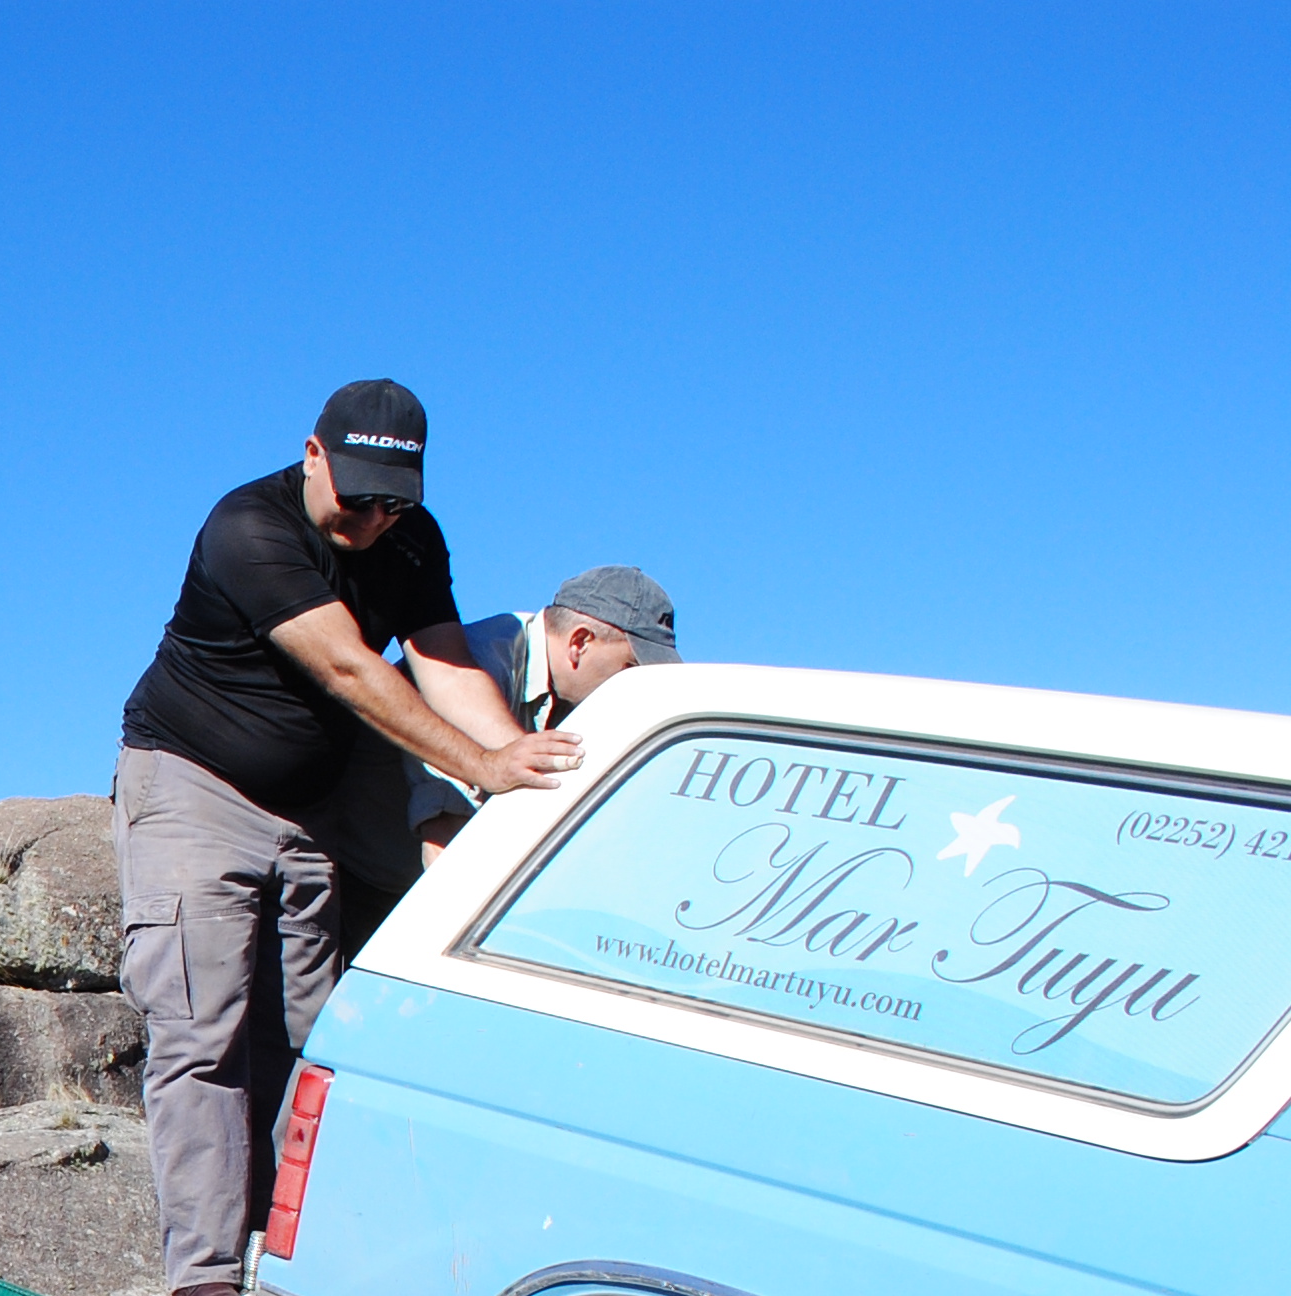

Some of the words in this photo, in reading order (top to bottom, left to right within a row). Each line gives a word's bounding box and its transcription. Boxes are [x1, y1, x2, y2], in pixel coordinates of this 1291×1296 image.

[344, 433, 423, 452] SALOMON
[670, 749, 907, 830] HOTEL
[1117, 810, 1235, 860] (02252)
[1244, 829, 1291, 860] 42
[596, 935, 922, 1020] www.hotelmartuyu.com
[675, 823, 918, 961] Mar
[932, 868, 1200, 1055] Tuyu
